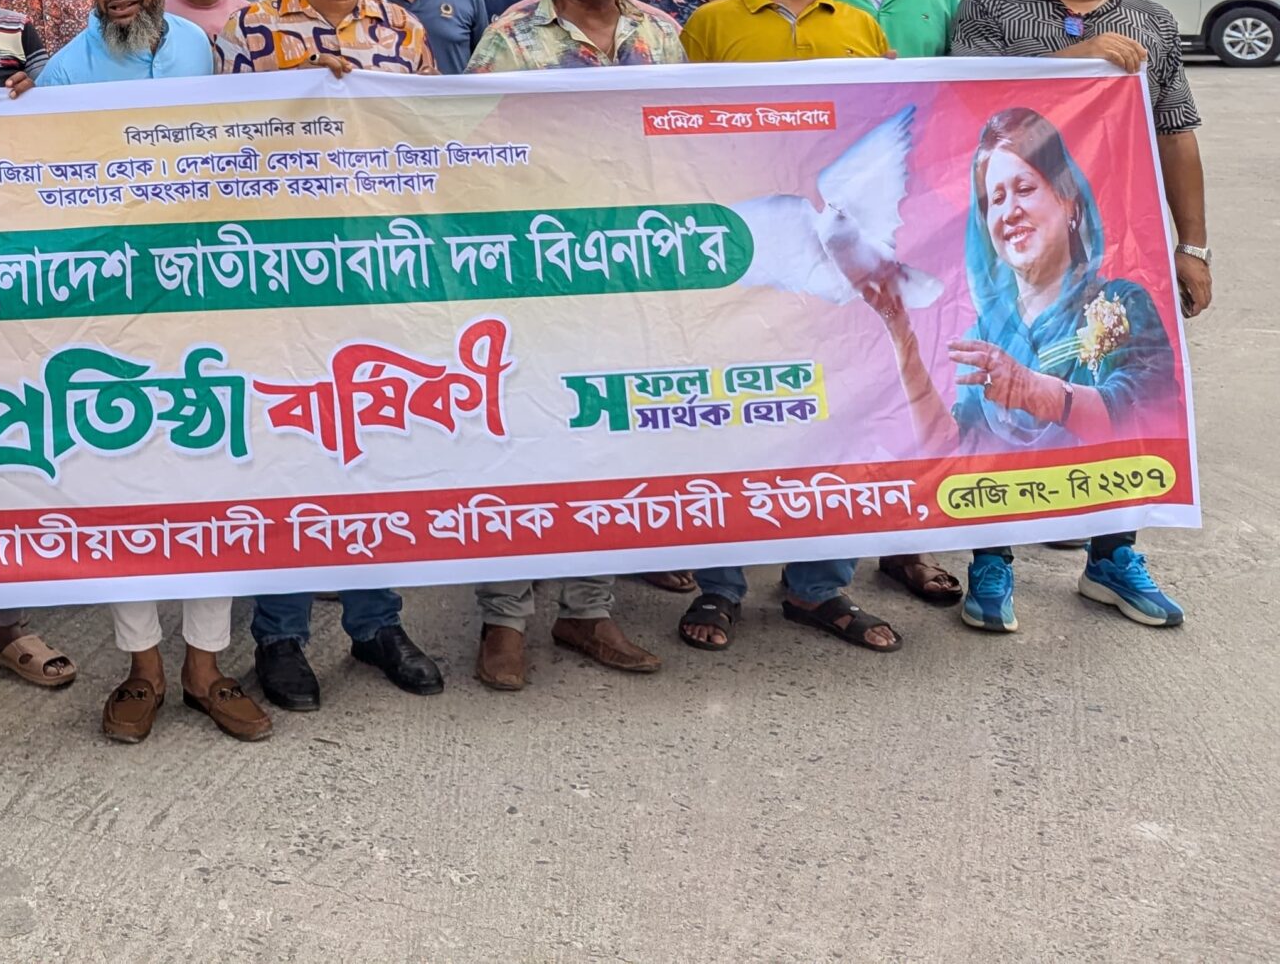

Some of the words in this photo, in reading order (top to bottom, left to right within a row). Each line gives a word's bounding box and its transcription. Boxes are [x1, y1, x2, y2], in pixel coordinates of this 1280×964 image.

[300, 116, 345, 136] রাহিম
[649, 110, 704, 130] শ্রমিক
[709, 110, 753, 128] ঐক্য
[756, 107, 830, 127] জিন্দাবাদ
[48, 162, 98, 181] অমর
[106, 157, 155, 179] হোক
[176, 147, 260, 176] দেশনেত্রী
[267, 150, 322, 171] বেগম
[328, 146, 389, 169] খালেদা
[394, 141, 441, 167] জিয়া
[446, 141, 530, 166] জিন্দাবাদ
[130, 180, 211, 202] অহংকার
[216, 177, 280, 198] তারেক
[285, 175, 350, 197] রহমান
[355, 169, 437, 193] জিন্দাবাদ
[148, 217, 435, 298] জাতীয়তাবাদী
[444, 234, 517, 286] দল
[561, 368, 709, 431] সফল
[724, 363, 812, 392] হোক
[635, 395, 731, 429] সার্থক
[743, 398, 817, 424] হোক
[948, 477, 1010, 511] রেজি
[1066, 468, 1092, 499] বি
[1098, 467, 1167, 497] ২২৩৭
[286, 503, 416, 558] বিদ্যুৎ
[425, 493, 559, 546] শ্রমিক
[566, 479, 732, 535] কর্মচারী
[740, 473, 929, 528] ইউনিয়ন,
